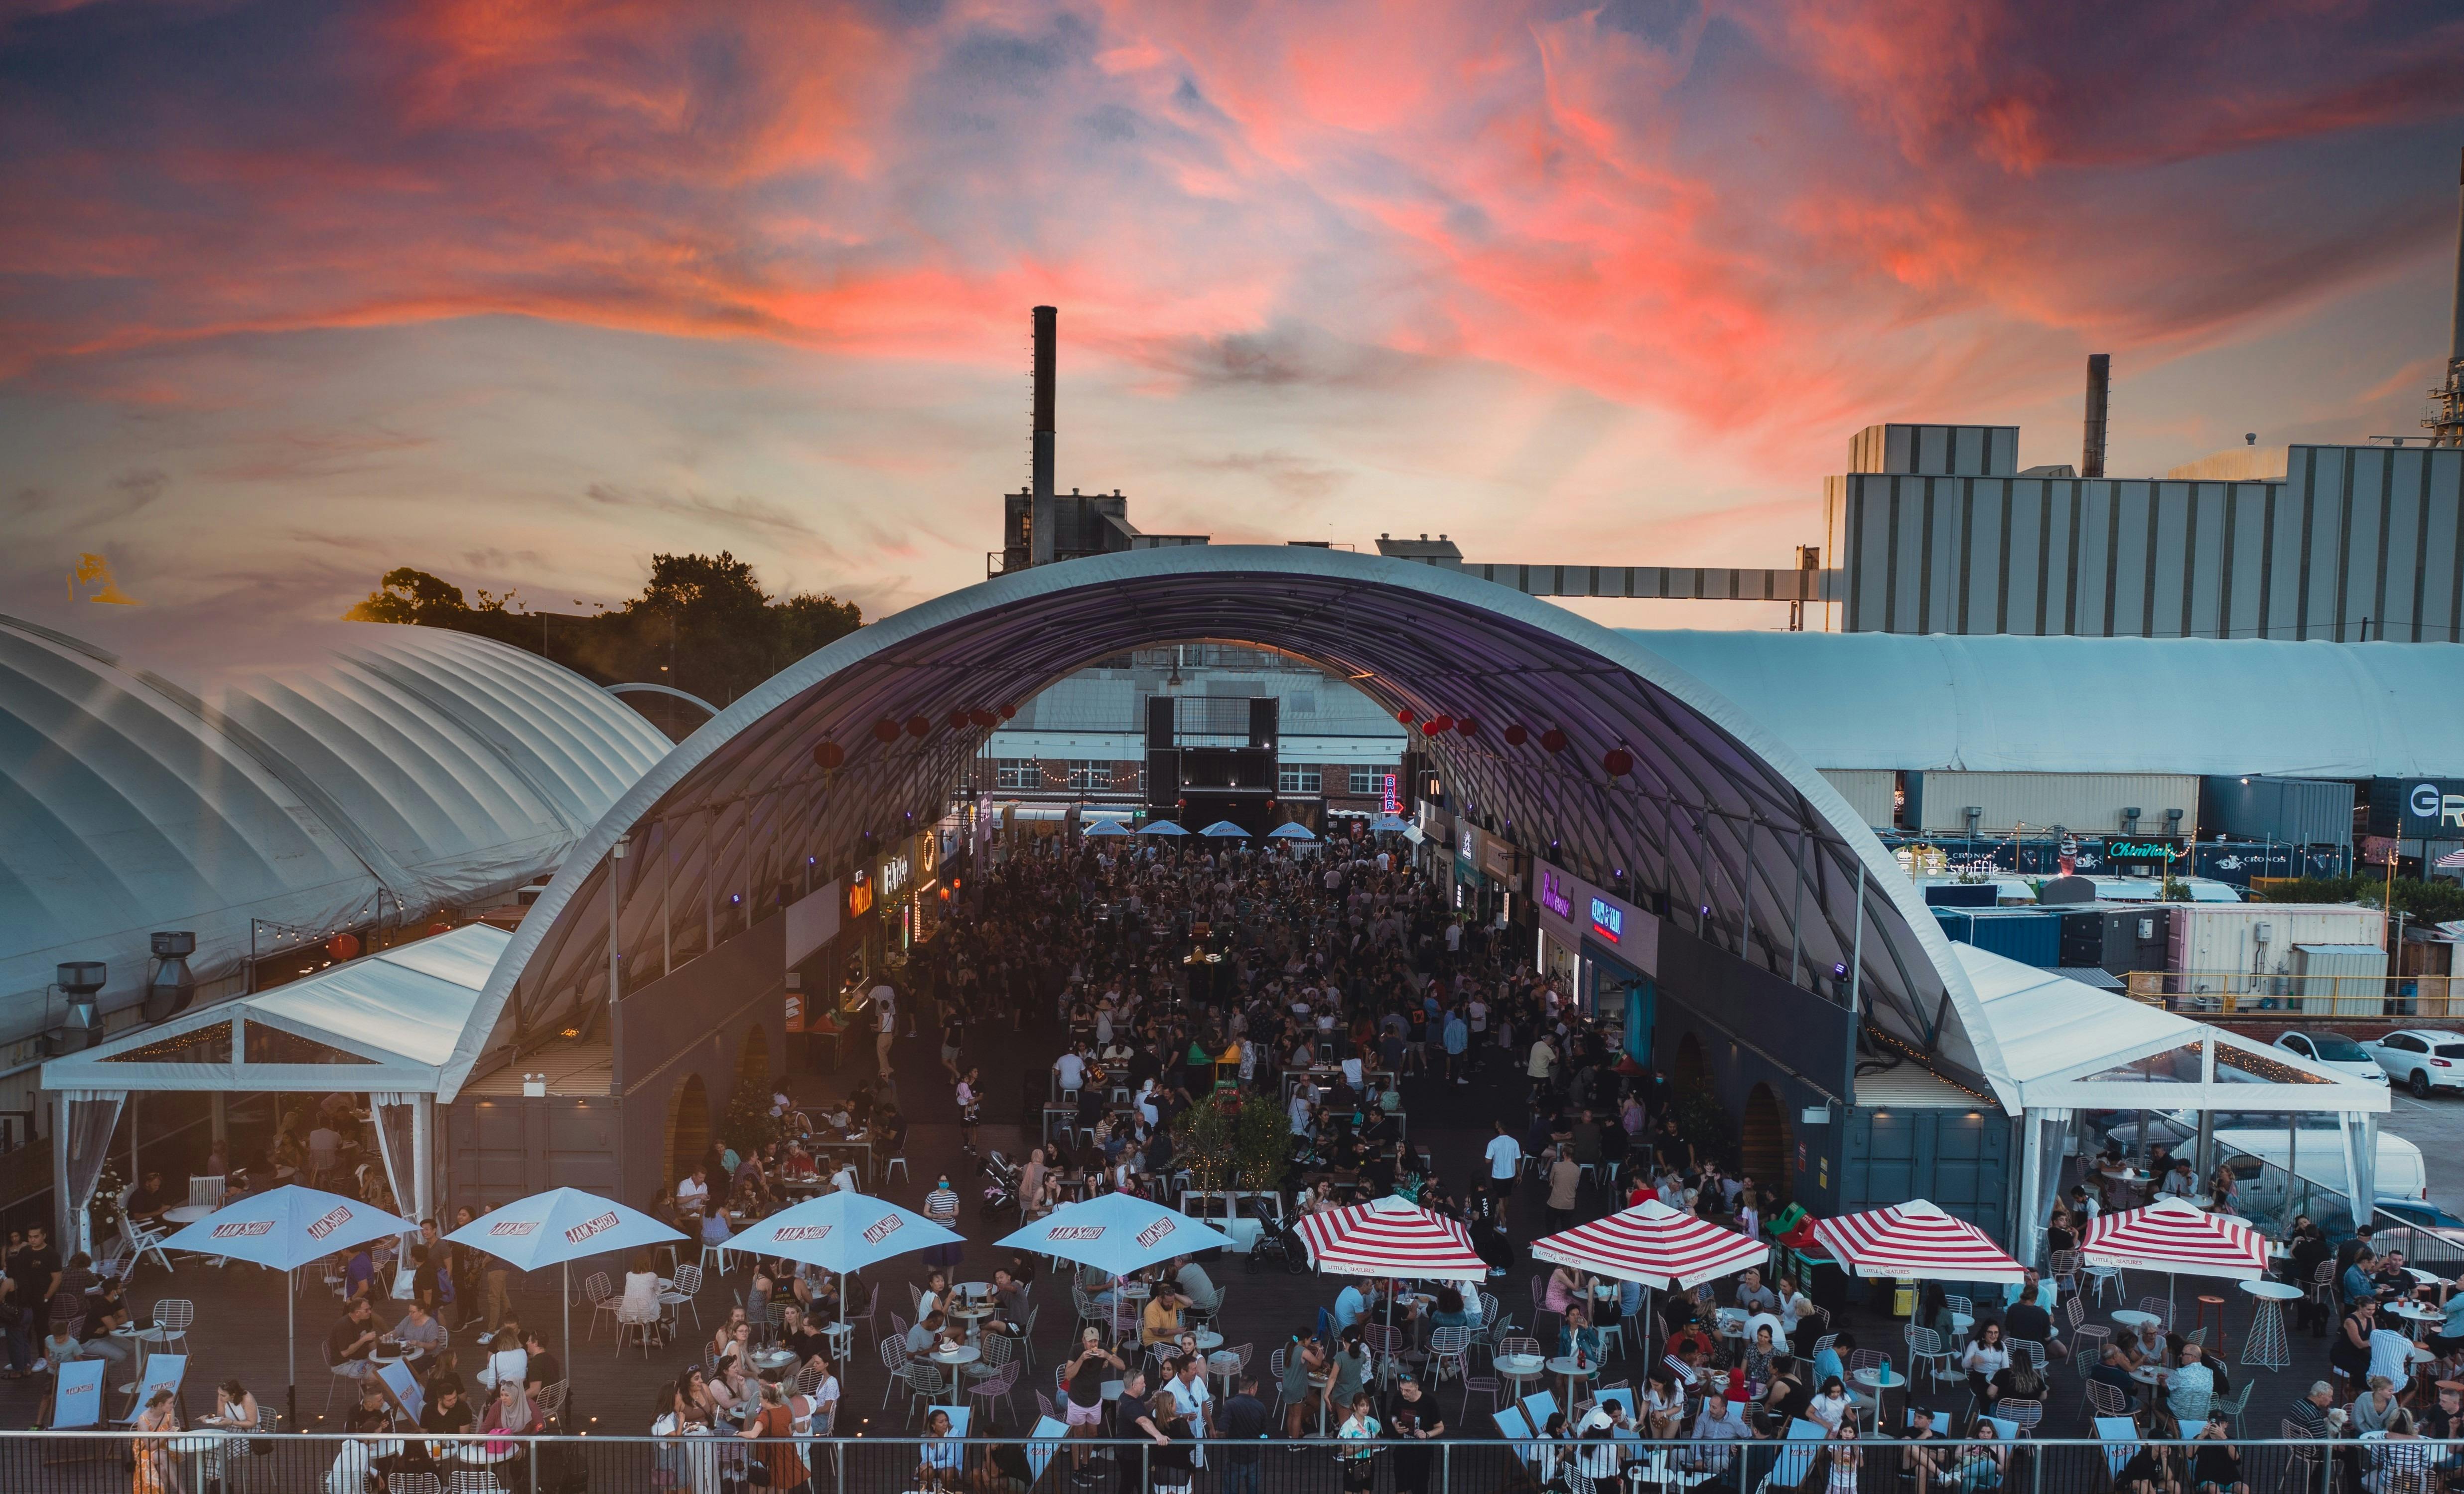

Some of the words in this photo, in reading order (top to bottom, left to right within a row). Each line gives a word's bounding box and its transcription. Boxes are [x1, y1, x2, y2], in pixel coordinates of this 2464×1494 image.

[1386, 777, 1394, 809] BAR
[855, 877, 872, 917] PAELLA
[209, 1222, 242, 1239] JAM
[240, 1220, 273, 1237] SHED
[309, 1220, 333, 1241] JAM
[322, 1207, 350, 1229] SHED
[568, 1224, 592, 1245] JAM
[587, 1213, 617, 1233] SHED
[772, 1226, 801, 1241] JAM
[798, 1224, 829, 1240] SHED
[863, 1225, 886, 1246] JAM
[876, 1215, 901, 1235] SHED
[1046, 1225, 1075, 1240] JAM
[1071, 1225, 1103, 1240] SHED
[1136, 1227, 1158, 1250] JAM
[1148, 1217, 1173, 1239] SHED
